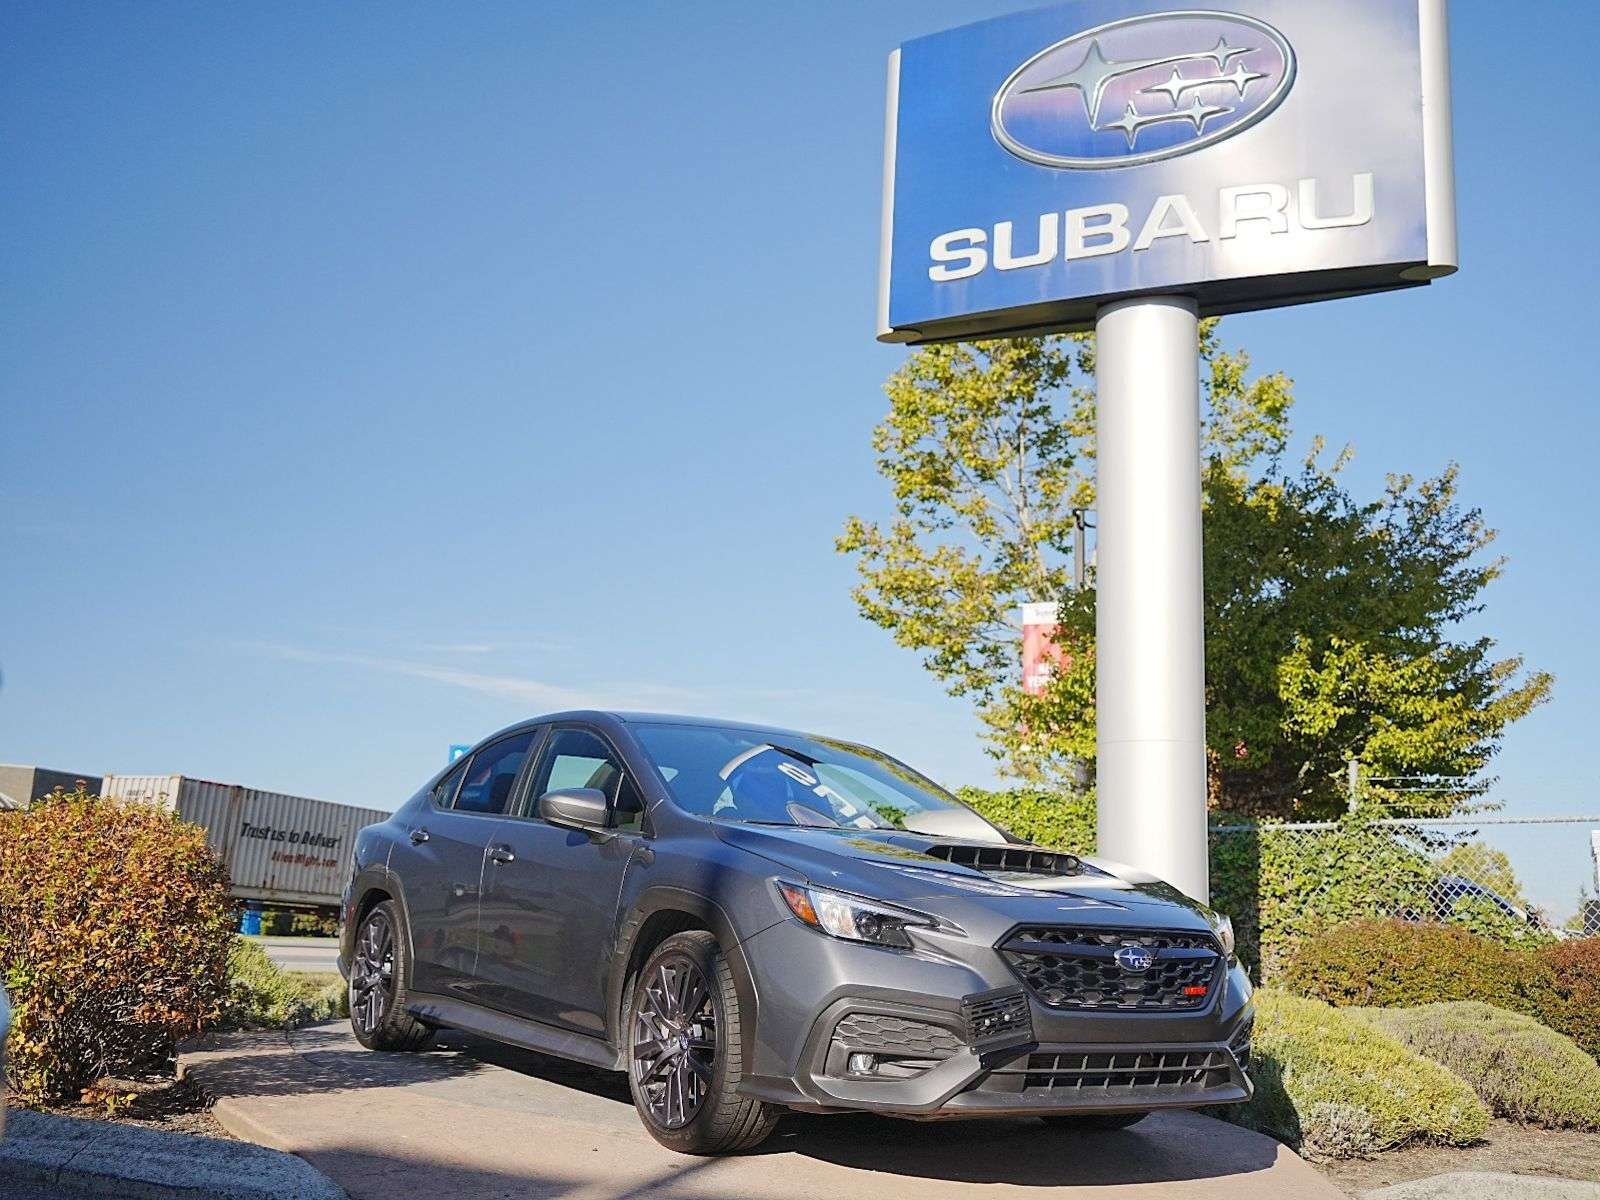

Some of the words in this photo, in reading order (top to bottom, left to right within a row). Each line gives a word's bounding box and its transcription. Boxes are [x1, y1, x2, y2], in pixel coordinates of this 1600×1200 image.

[928, 172, 1373, 282] SUBARU
[241, 822, 271, 840] Trust
[271, 829, 286, 842] us
[288, 829, 300, 843] to
